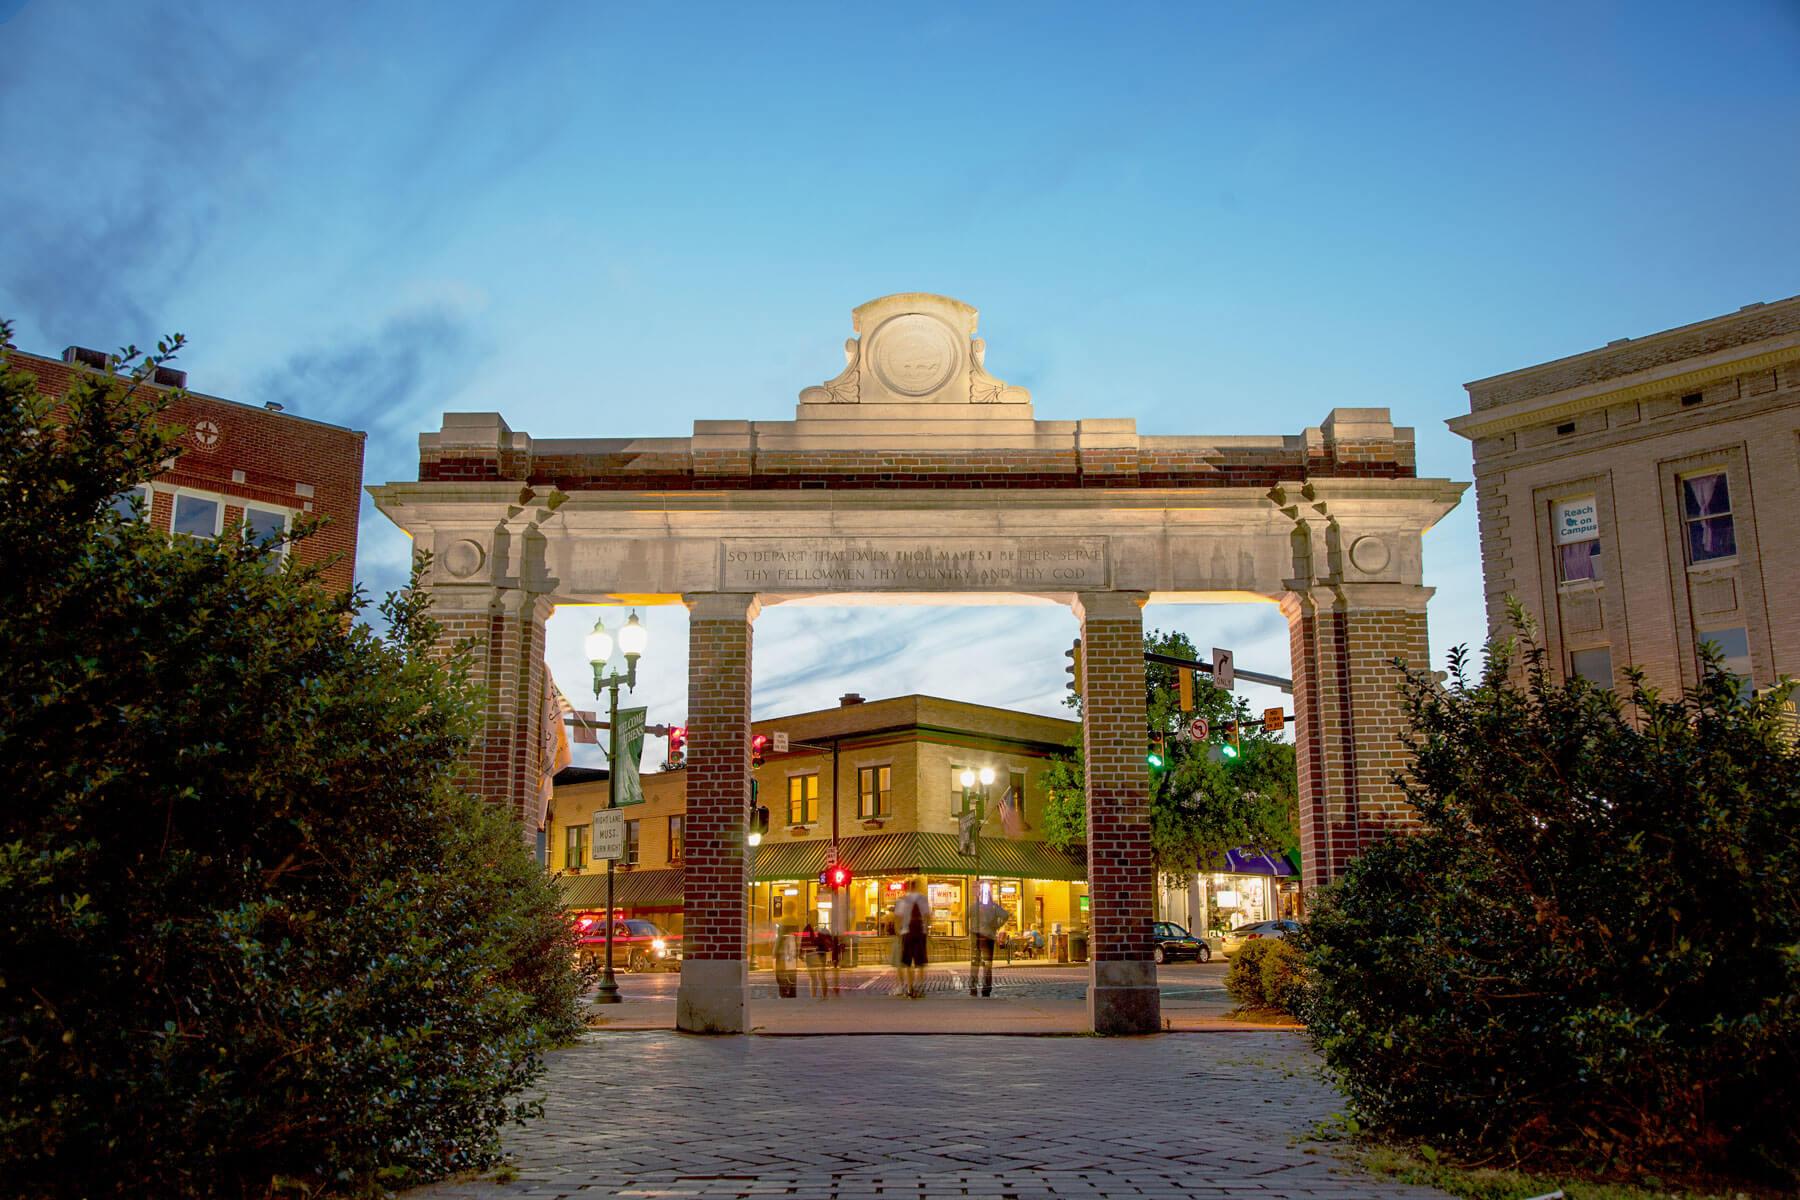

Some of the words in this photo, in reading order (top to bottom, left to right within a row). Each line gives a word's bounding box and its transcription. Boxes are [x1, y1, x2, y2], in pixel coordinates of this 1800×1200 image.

[1564, 506, 1593, 517] Reach
[1561, 525, 1597, 535] Campus
[727, 551, 748, 562] SO
[753, 551, 806, 562] DEPART
[814, 551, 845, 562] THAT
[852, 551, 889, 561] DAILY
[937, 551, 992, 561] MAYEST
[1000, 551, 1050, 561] BETTER
[1060, 551, 1102, 561] SERVE
[744, 569, 769, 581] THY
[778, 569, 865, 581] FELLOWMEN
[873, 569, 899, 581] THY
[906, 568, 971, 580] COUNTRY
[980, 568, 1010, 579] AND
[1017, 568, 1044, 580] THY
[1053, 568, 1085, 579] GOD
[1216, 676, 1232, 686] ONLY
[618, 711, 645, 736] WELCOME
[609, 814, 622, 824] LANE
[599, 828, 617, 840] MUST
